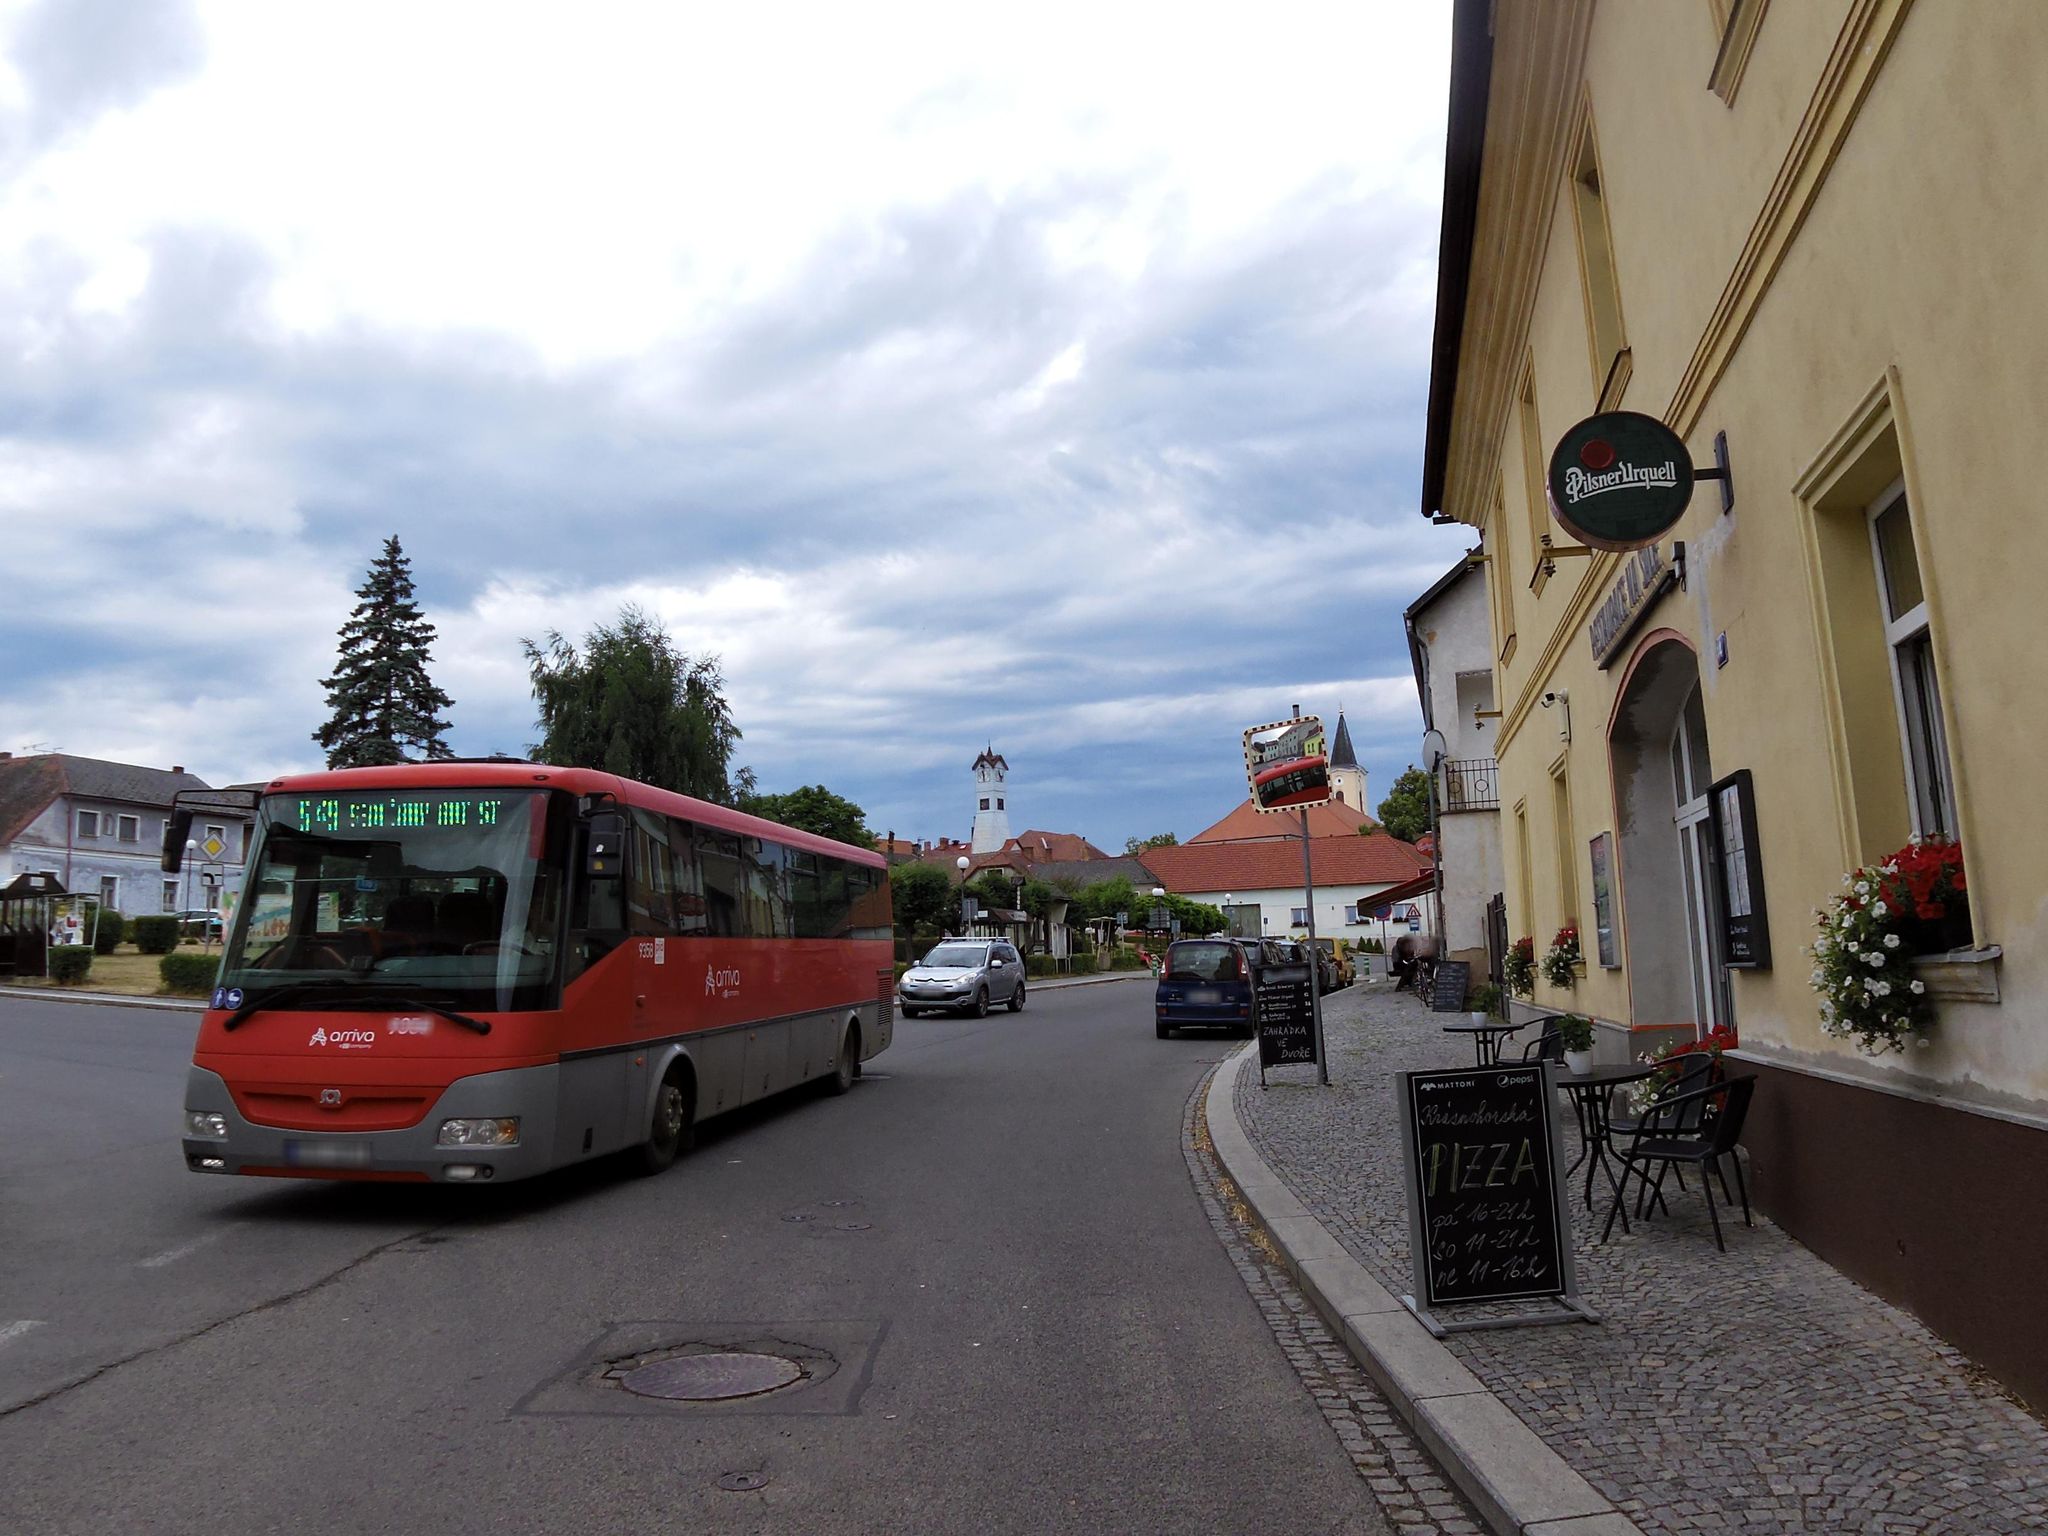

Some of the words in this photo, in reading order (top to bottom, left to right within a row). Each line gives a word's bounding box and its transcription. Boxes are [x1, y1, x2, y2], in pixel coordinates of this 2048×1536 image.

[1565, 466, 1622, 504] Pilsner
[1619, 460, 1676, 490] Urquell
[716, 965, 740, 987] arriva
[330, 1028, 375, 1042] arriva
[1437, 1080, 1475, 1090] MATTONI
[1510, 1074, 1534, 1085] pepsi
[1422, 1136, 1540, 1197] PIZZA
